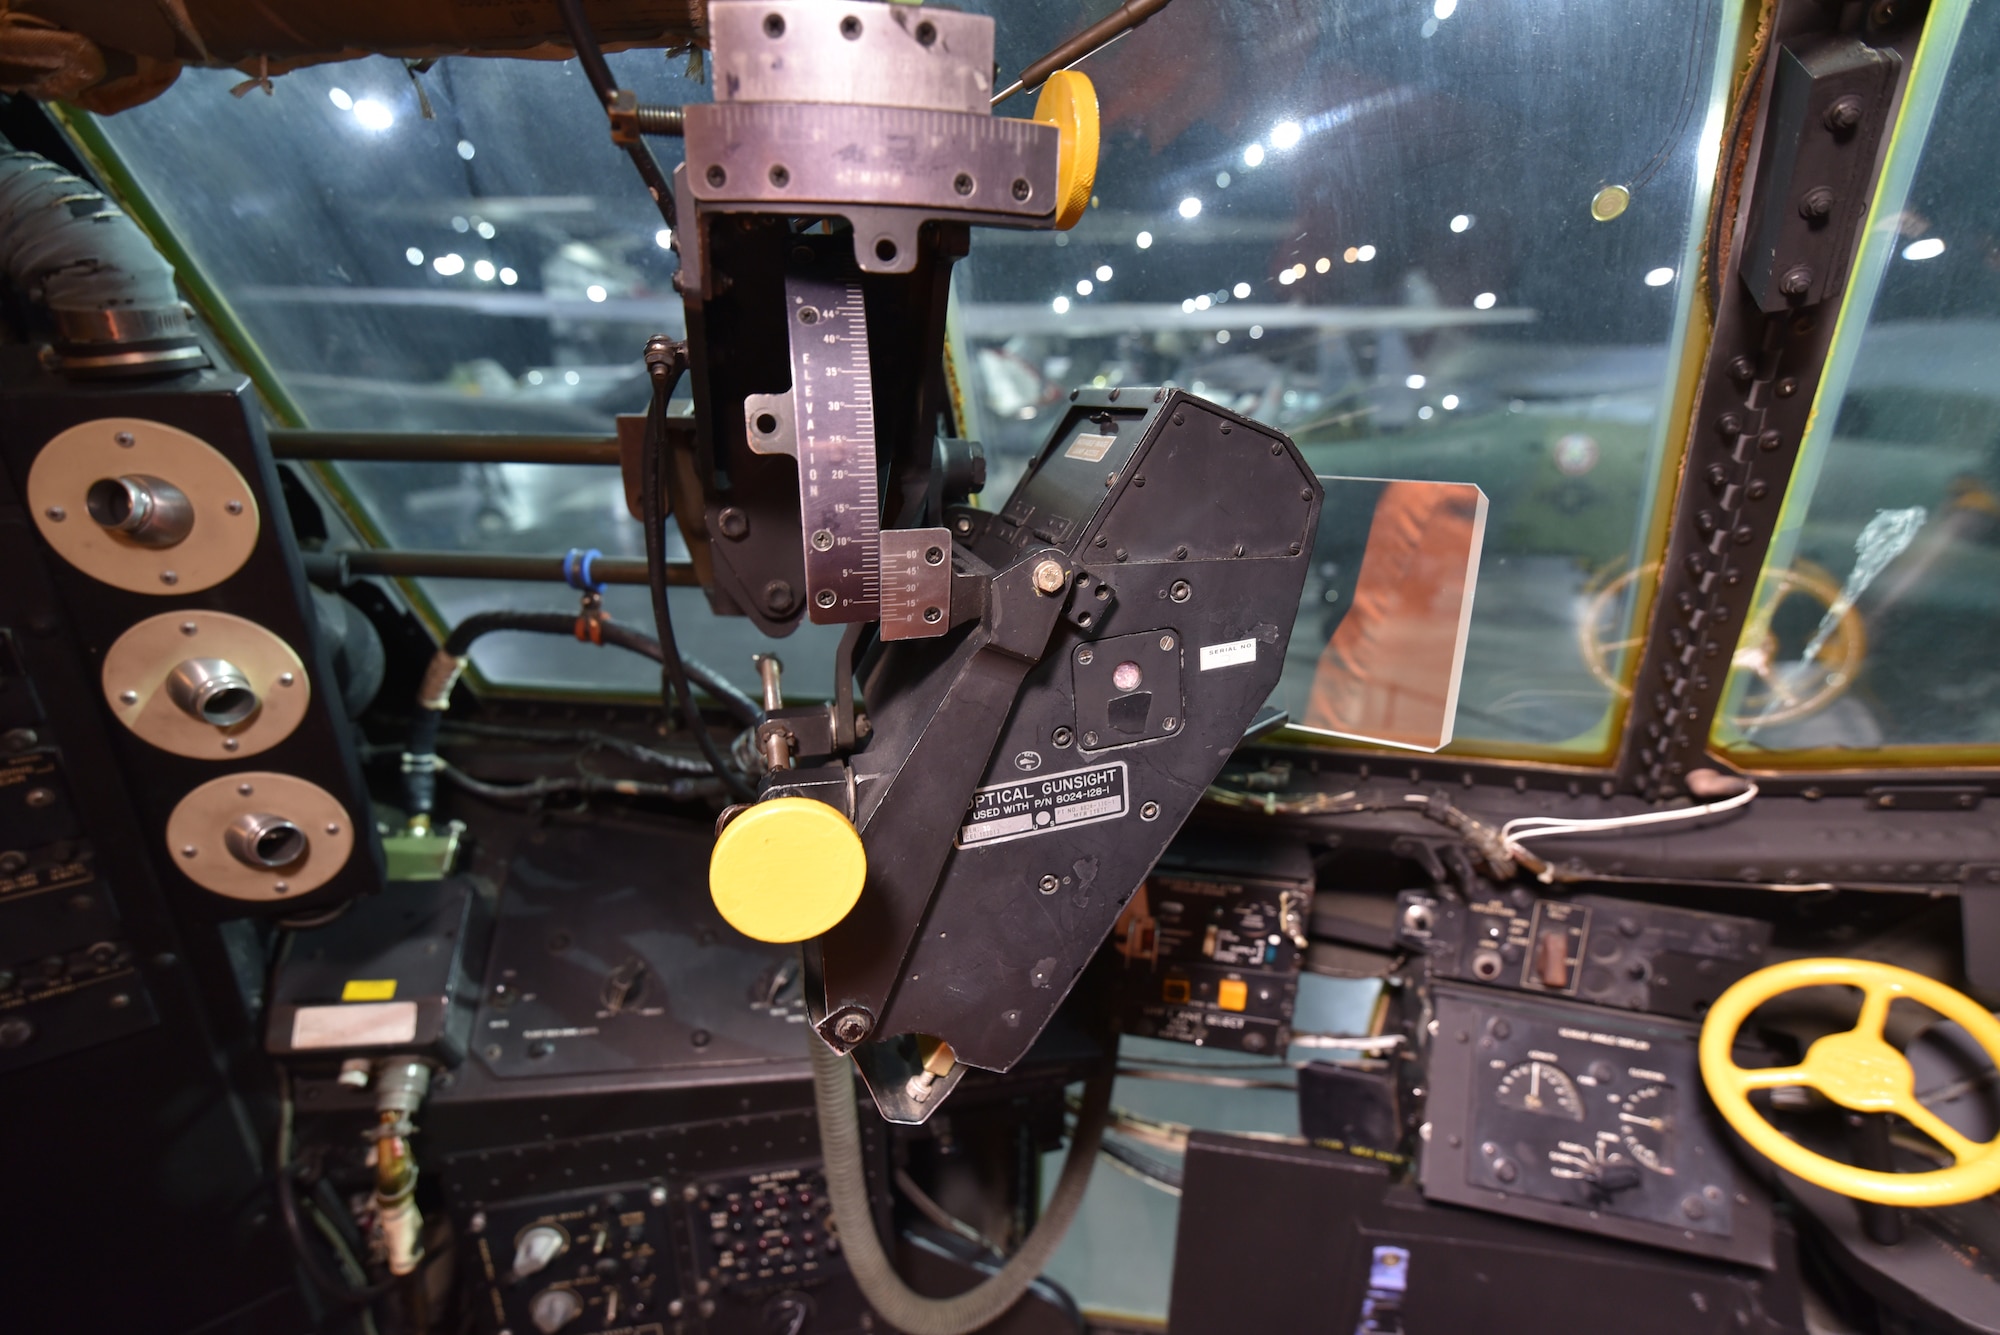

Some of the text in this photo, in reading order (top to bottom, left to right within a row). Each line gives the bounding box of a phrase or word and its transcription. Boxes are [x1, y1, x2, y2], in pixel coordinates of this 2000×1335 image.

[822, 309, 840, 319] 44°
[823, 334, 841, 344] 40°
[825, 367, 843, 377] 35°
[828, 401, 846, 411] 30°
[802, 352, 819, 498] ELEVATION
[831, 469, 849, 480] 20°
[834, 503, 850, 513] 15°
[836, 536, 852, 546] 10°
[842, 568, 853, 578] 5°
[842, 598, 853, 608] 0°
[1208, 646, 1237, 656] SERIAL
[1041, 768, 1117, 796] GUNSIGHT
[973, 785, 1110, 821] USED WITH P/N 8024-128-1
